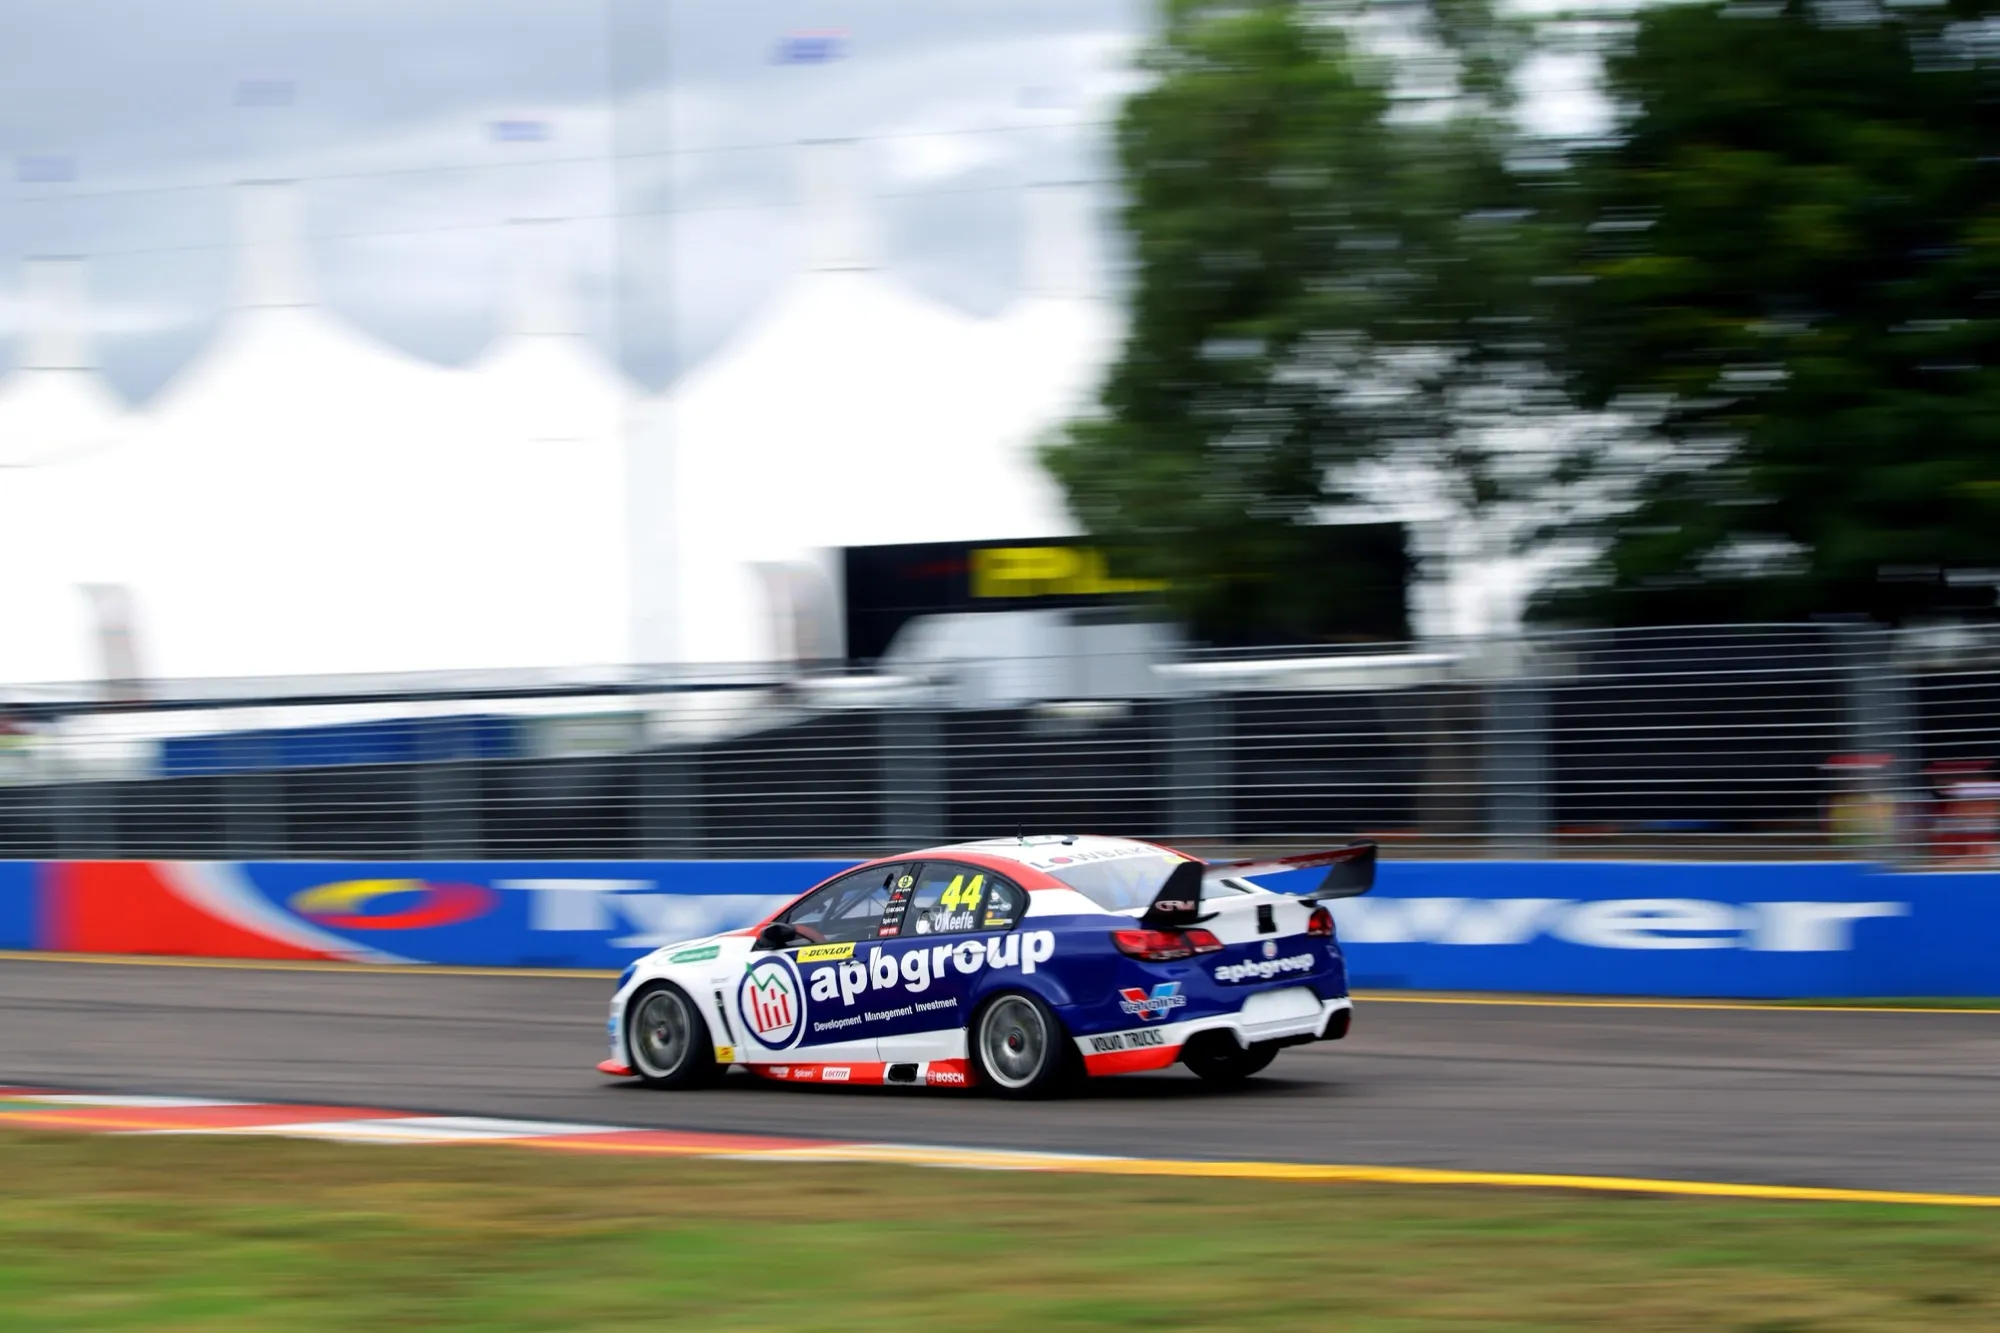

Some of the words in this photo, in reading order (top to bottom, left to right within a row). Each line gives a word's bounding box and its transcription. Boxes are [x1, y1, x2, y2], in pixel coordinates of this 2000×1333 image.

[941, 875, 984, 911] 44
[808, 946, 851, 957] DUNLOP
[810, 930, 1055, 1006] apbgroup
[1215, 953, 1314, 983] apbgroup
[814, 1014, 862, 1032] Development
[864, 1005, 913, 1023] Management
[915, 997, 958, 1013] Investment
[1089, 1034, 1124, 1052] VOLVO
[1124, 1029, 1165, 1048] TRUCKS
[825, 1069, 848, 1078] LOCTITE
[936, 1073, 964, 1083] BOSCH
